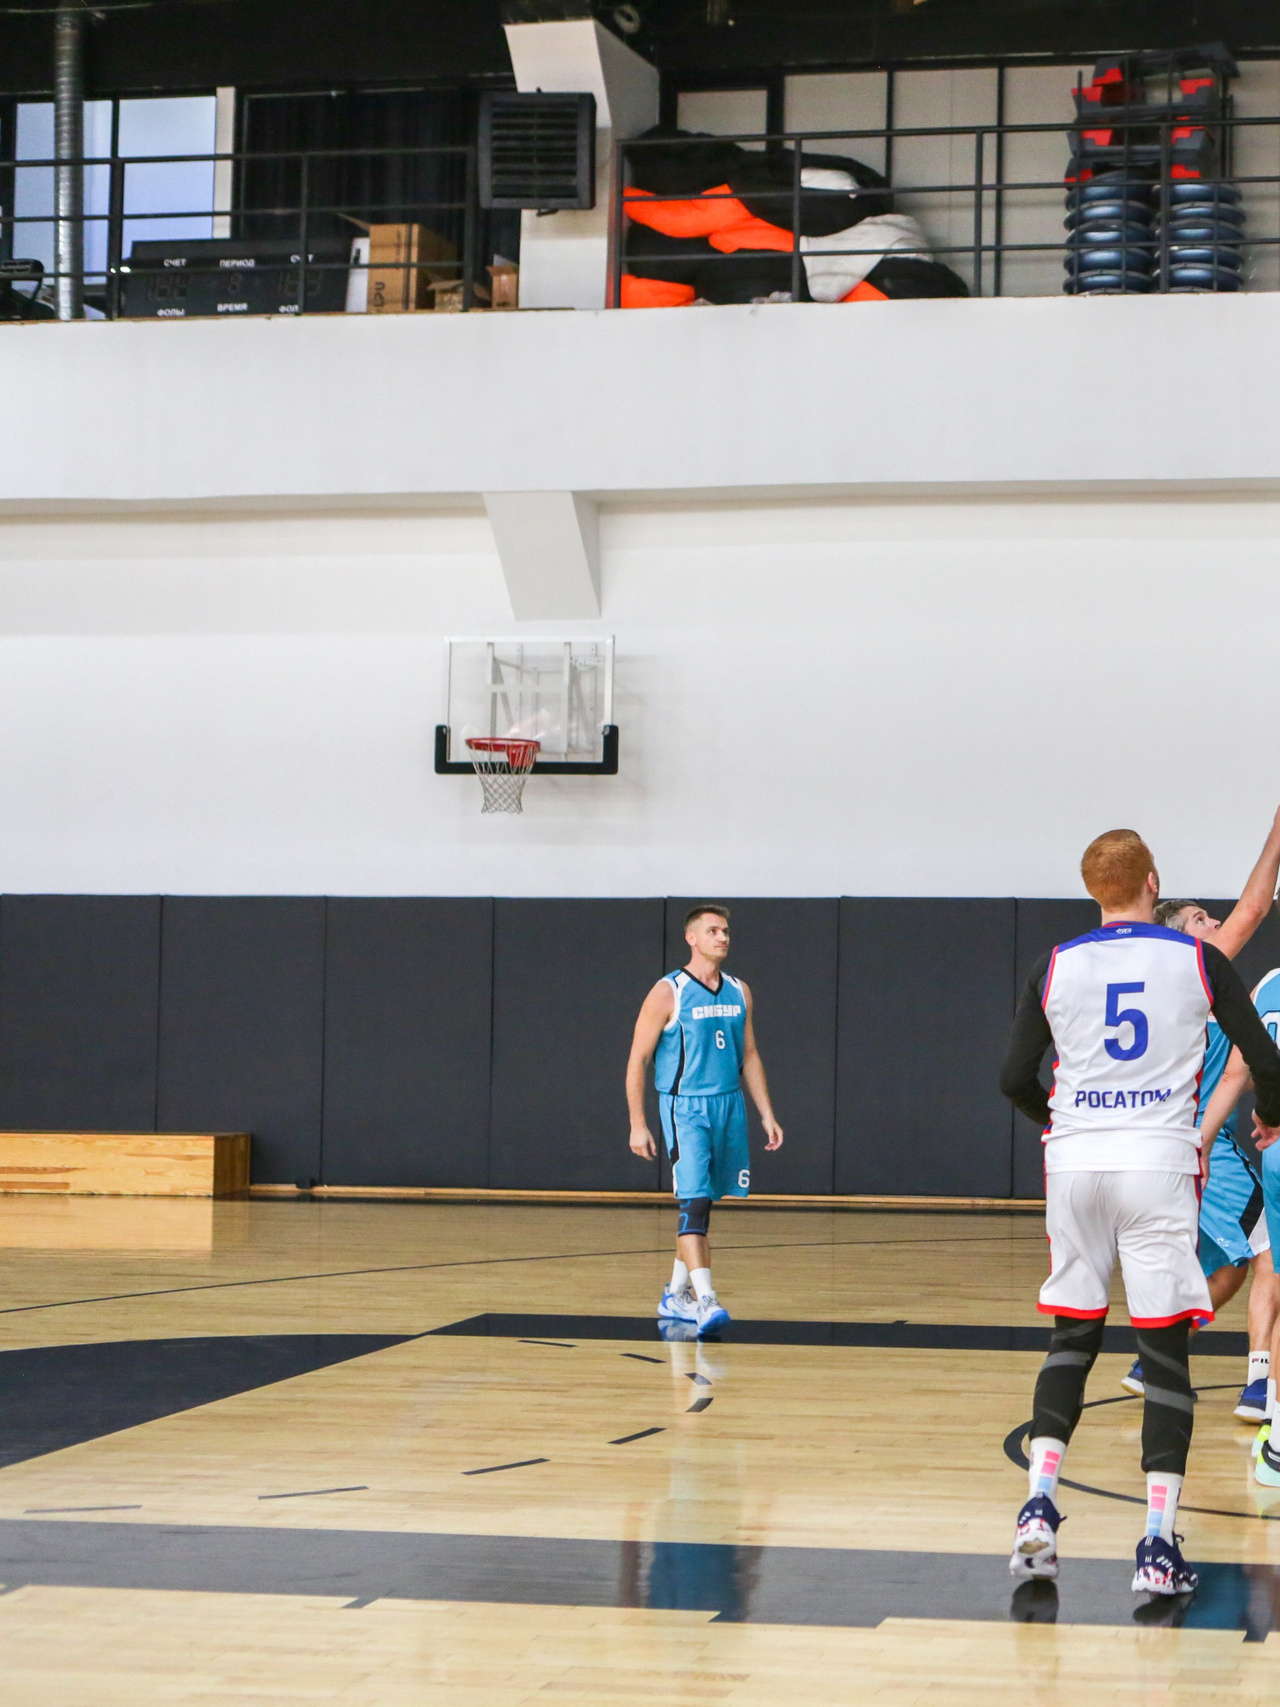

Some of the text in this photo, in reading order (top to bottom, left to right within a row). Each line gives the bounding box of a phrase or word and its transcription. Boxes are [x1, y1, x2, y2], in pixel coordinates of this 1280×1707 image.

[219, 259, 255, 268] ПЕРИОД
[290, 254, 314, 263] СЧТ
[157, 308, 185, 317] ФОЛЫ
[217, 303, 248, 312] ВРЕМЯ
[279, 305, 299, 313] ФОЛ
[692, 1004, 741, 1020] СИБУР
[1104, 981, 1148, 1061] 5
[715, 1029, 726, 1050] 6
[1075, 1089, 1172, 1108] РОСАТОМ
[738, 1169, 750, 1188] 6
